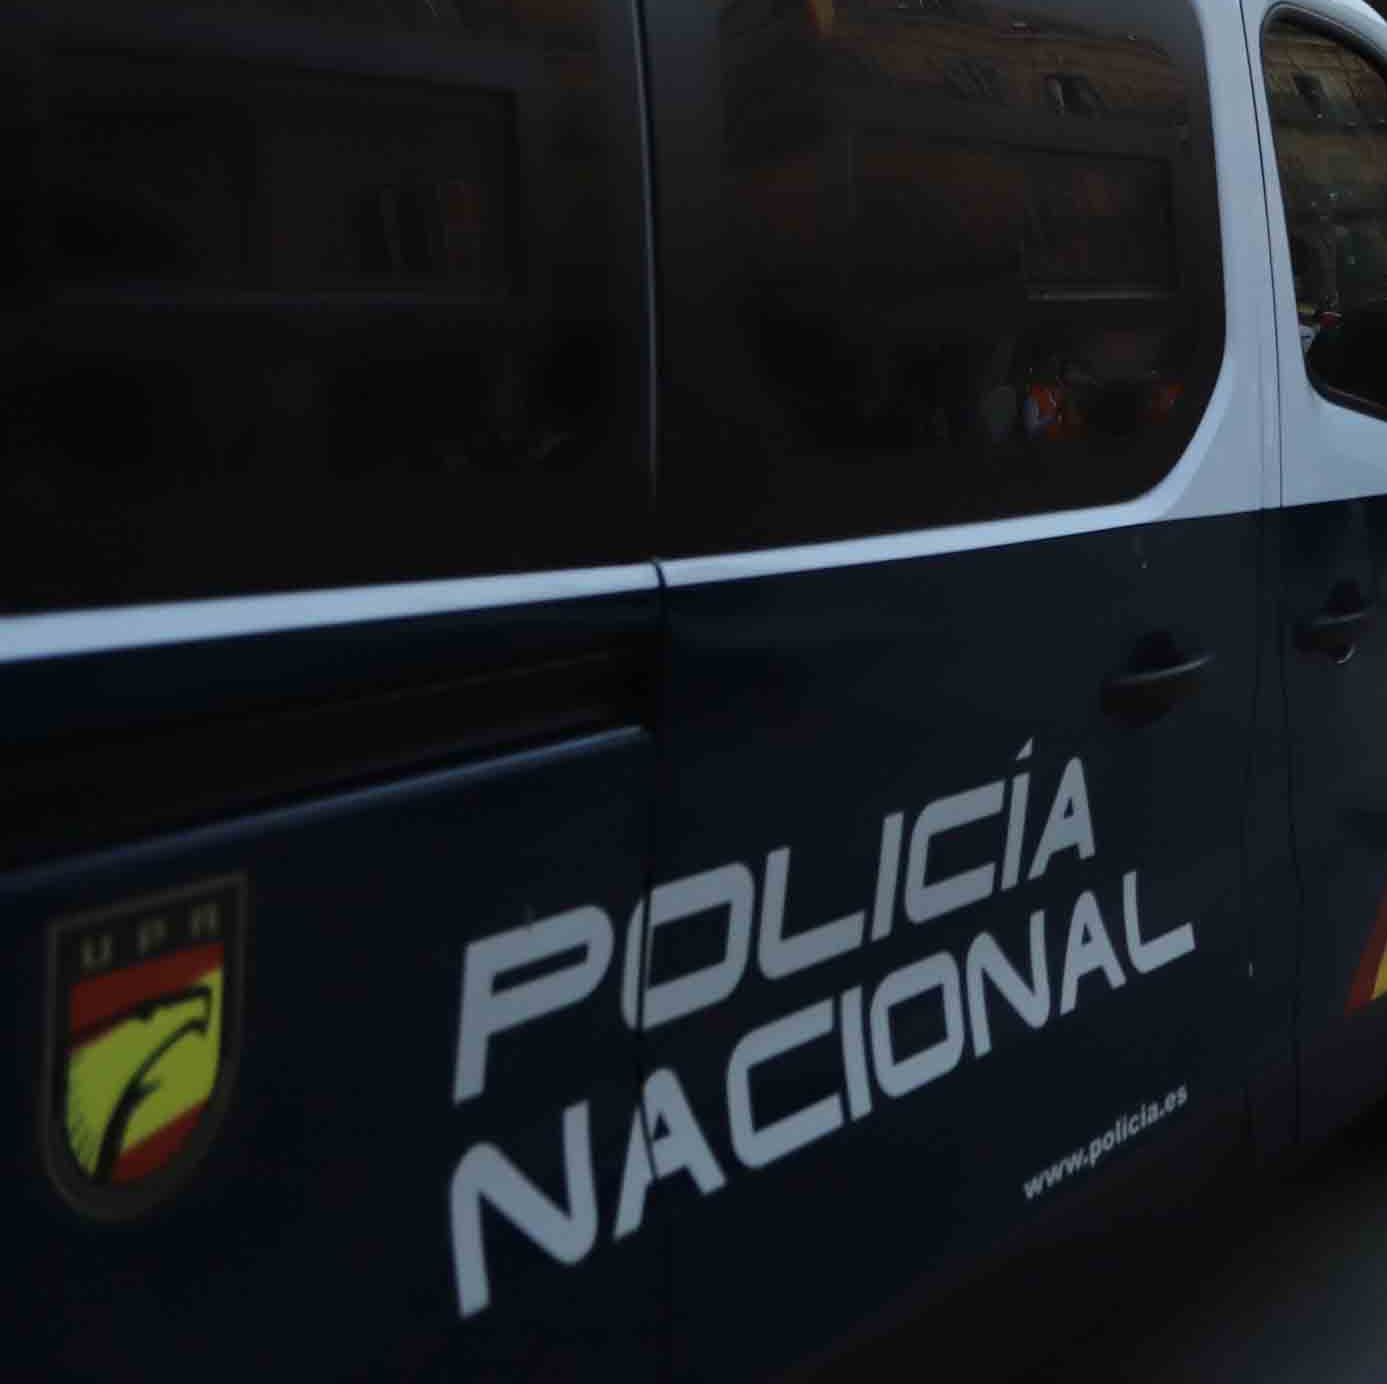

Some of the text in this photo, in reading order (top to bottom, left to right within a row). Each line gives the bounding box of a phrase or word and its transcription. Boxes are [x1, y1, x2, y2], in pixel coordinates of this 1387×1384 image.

[450, 871, 1196, 1319] NACIONAL
[454, 737, 1095, 1104] POLICÍA
[1023, 1081, 1190, 1199] www.policia.es
